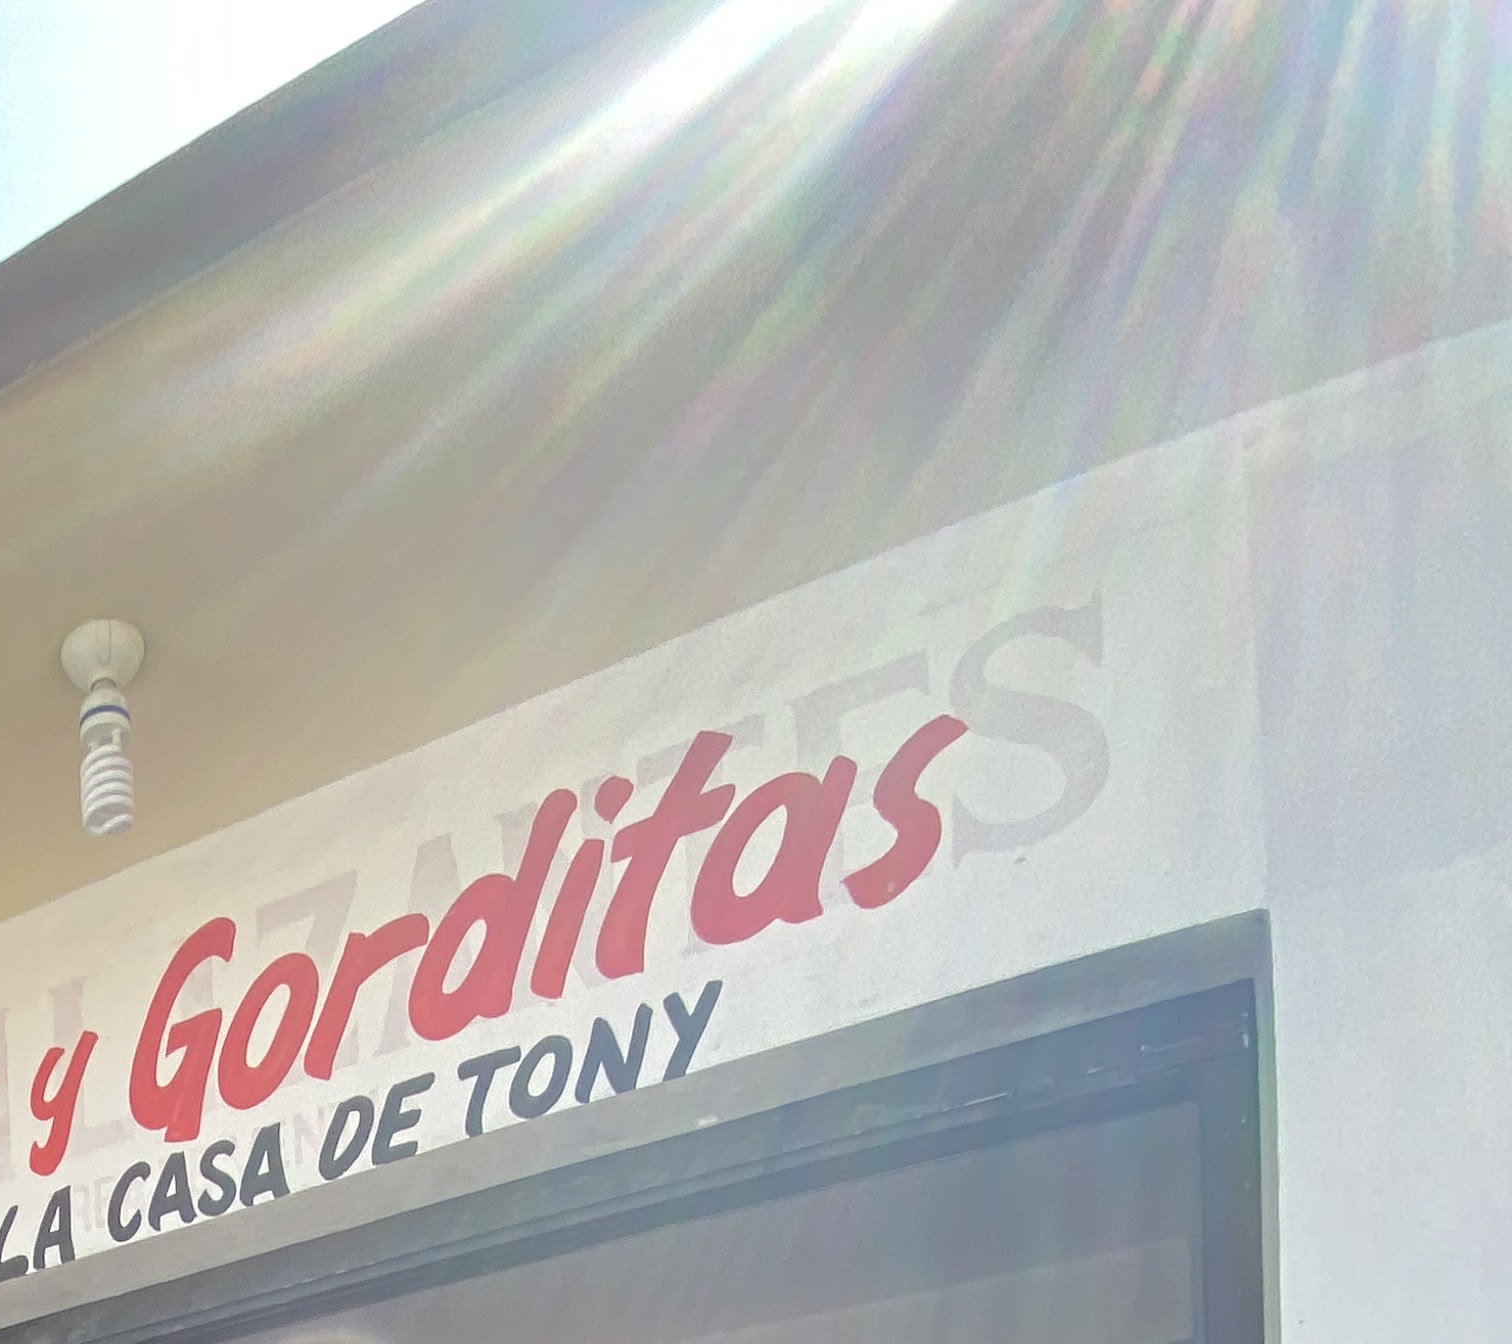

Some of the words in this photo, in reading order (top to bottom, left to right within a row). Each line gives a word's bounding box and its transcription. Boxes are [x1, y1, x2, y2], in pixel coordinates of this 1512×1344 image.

[128, 718, 965, 1145] Gorditas
[107, 1121, 289, 1243] CASA
[319, 1072, 435, 1182] DE
[457, 979, 723, 1138] TONY
